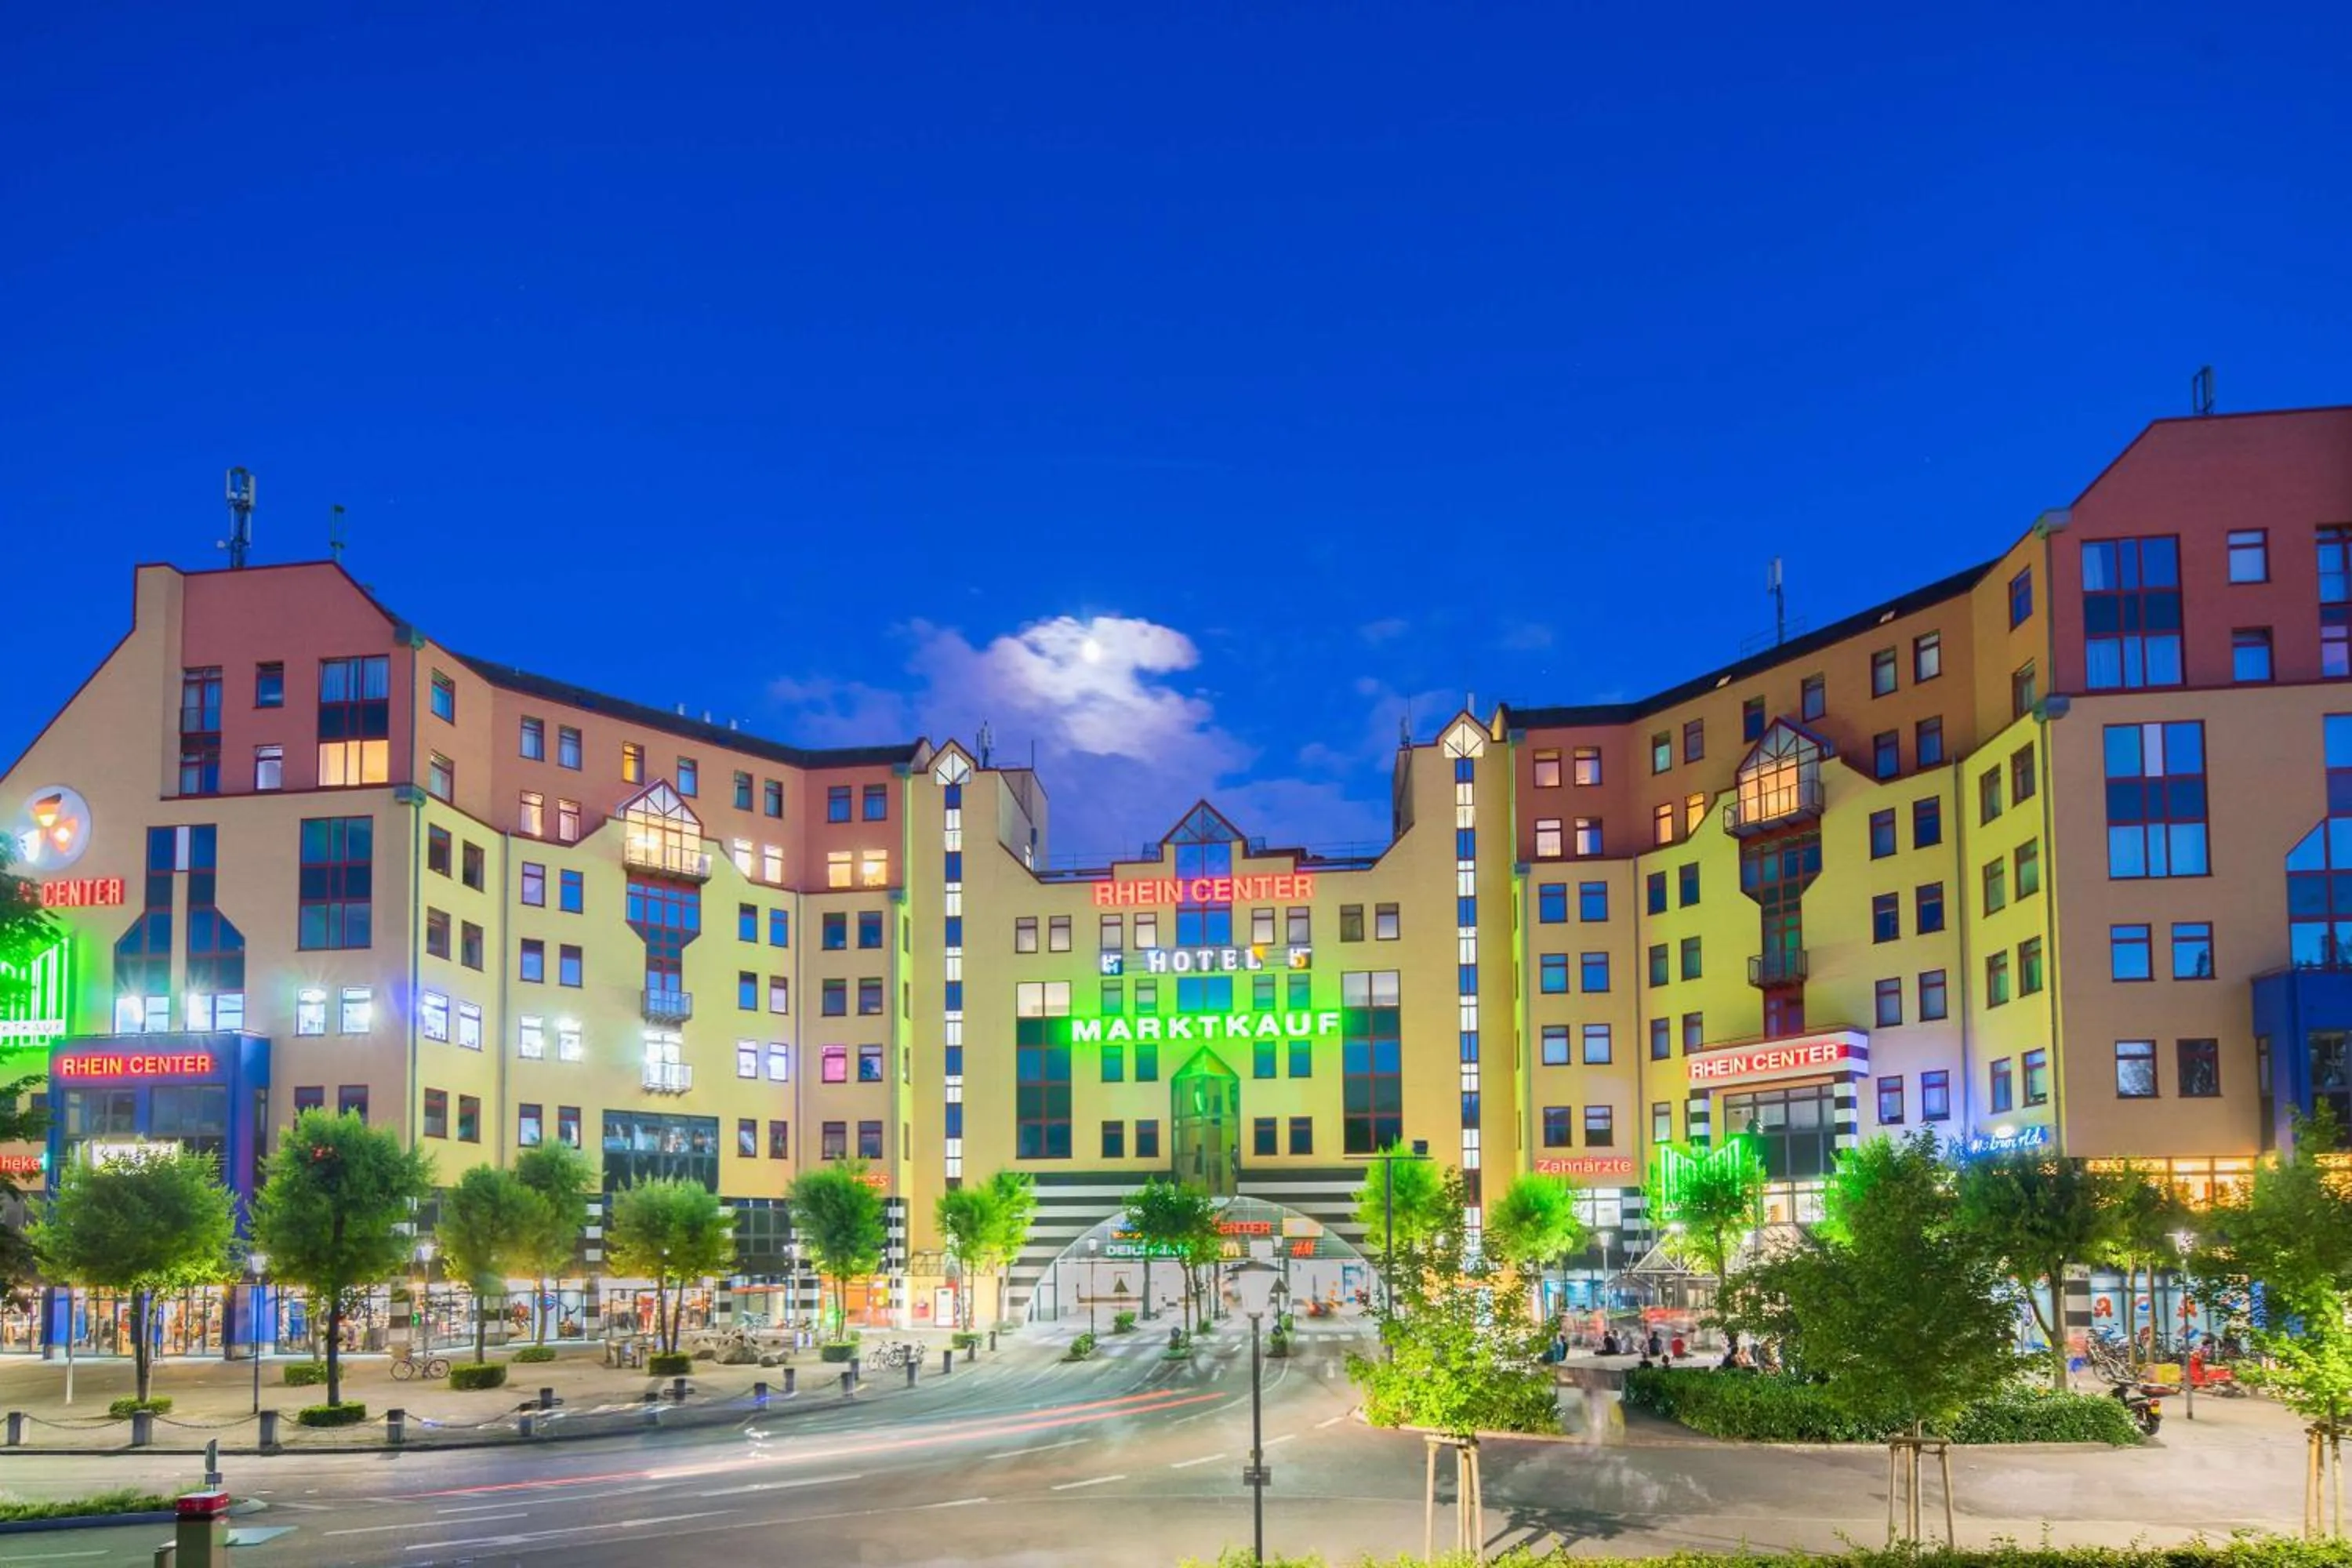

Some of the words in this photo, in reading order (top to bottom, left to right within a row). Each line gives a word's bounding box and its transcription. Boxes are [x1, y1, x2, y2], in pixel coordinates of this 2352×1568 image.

[42, 878, 122, 906] CENTER
[1096, 880, 1184, 905] RHEIN
[1191, 876, 1314, 902] CENTER
[1147, 947, 1261, 972] HOTEL
[1072, 1012, 1339, 1042] MARKTKAUF
[63, 1058, 122, 1075] RHEIN
[129, 1055, 211, 1073] CENTER
[1692, 1058, 1748, 1079] RHEIN
[1752, 1044, 1838, 1070] CENTER
[1537, 1156, 1632, 1174] Zahnärzte
